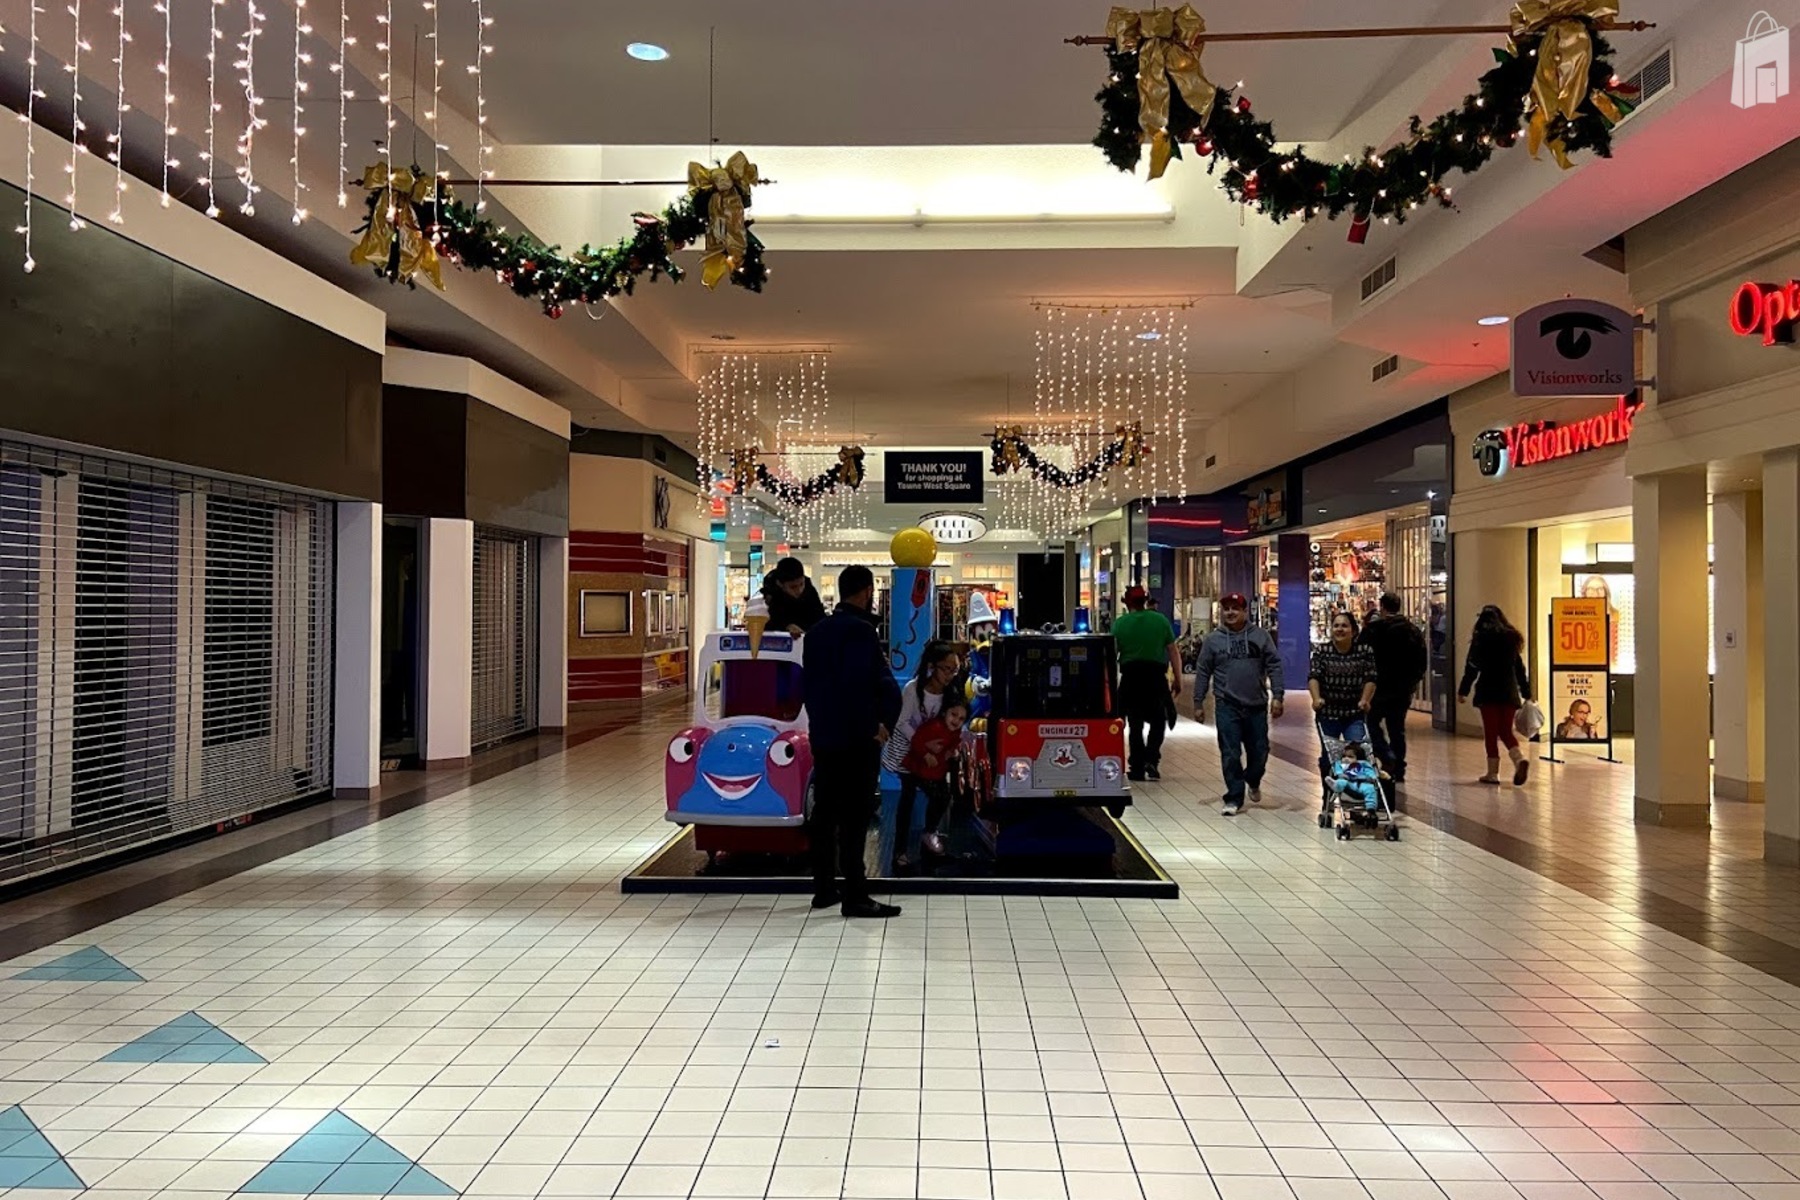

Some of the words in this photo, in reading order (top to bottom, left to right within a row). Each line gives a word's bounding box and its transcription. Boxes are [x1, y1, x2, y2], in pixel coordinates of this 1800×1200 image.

[1729, 279, 1800, 346] Opt
[1528, 370, 1623, 385] Visionworks
[1505, 395, 1645, 468] Visionwork
[902, 463, 937, 473] THANK
[940, 463, 966, 473] YOU!
[905, 474, 916, 482] for
[917, 474, 954, 483] shopping
[954, 474, 963, 482] at
[897, 482, 922, 490] Towne
[923, 482, 943, 490] West
[944, 482, 970, 491] Square
[1561, 622, 1599, 650] 50%
